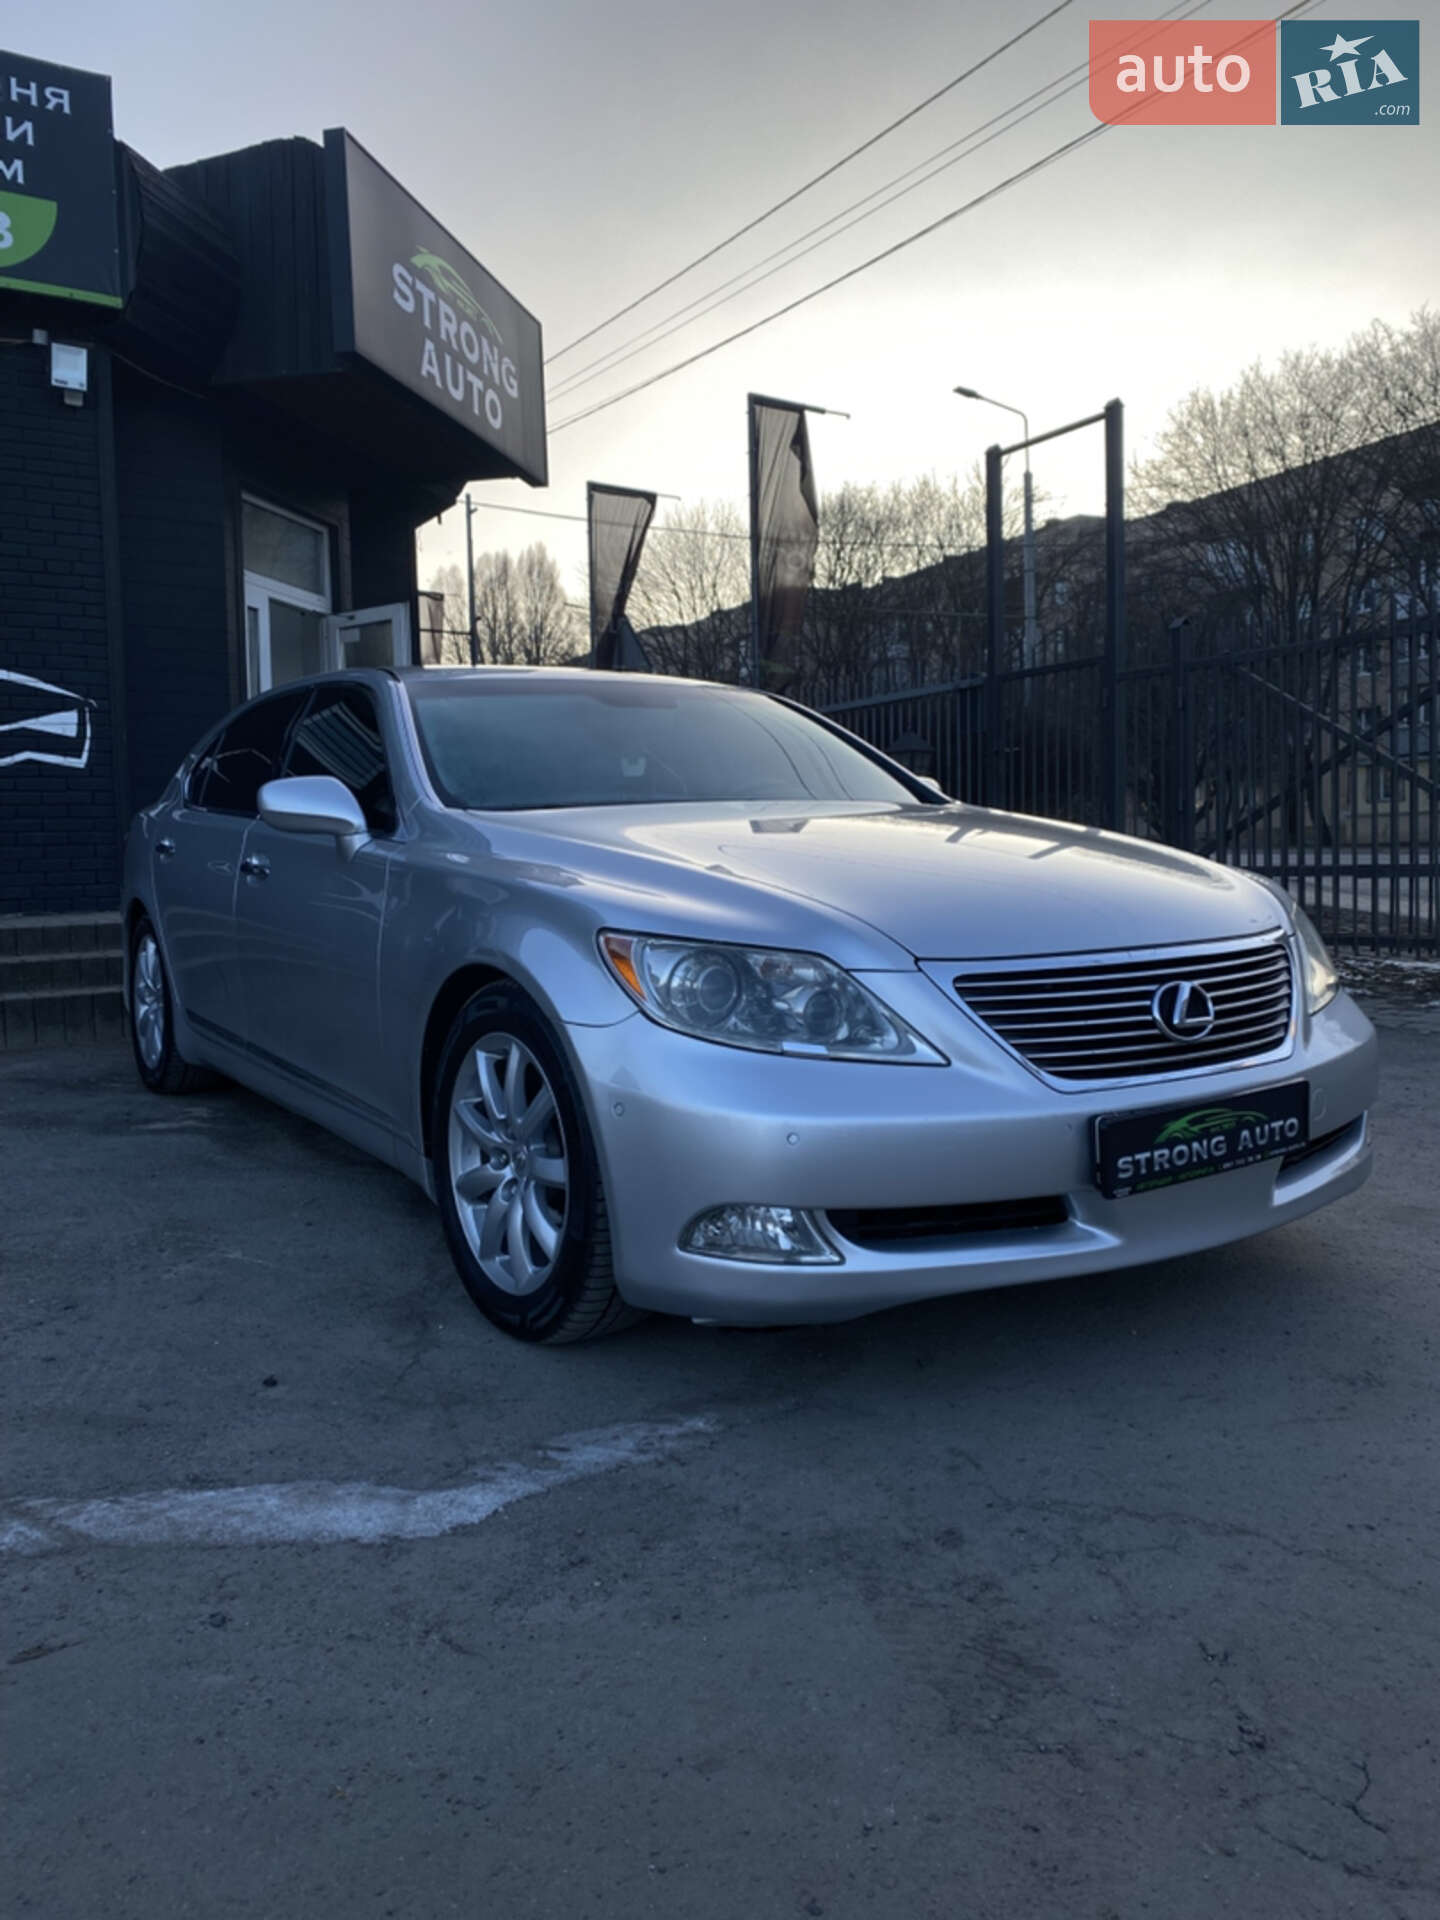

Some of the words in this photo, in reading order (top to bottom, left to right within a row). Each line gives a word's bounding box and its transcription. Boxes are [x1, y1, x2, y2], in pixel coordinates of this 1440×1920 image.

[392, 263, 519, 399] STRONG
[421, 337, 503, 430] AUTO
[1117, 1135, 1228, 1179] STRONG
[1238, 1117, 1299, 1151] AUTO
